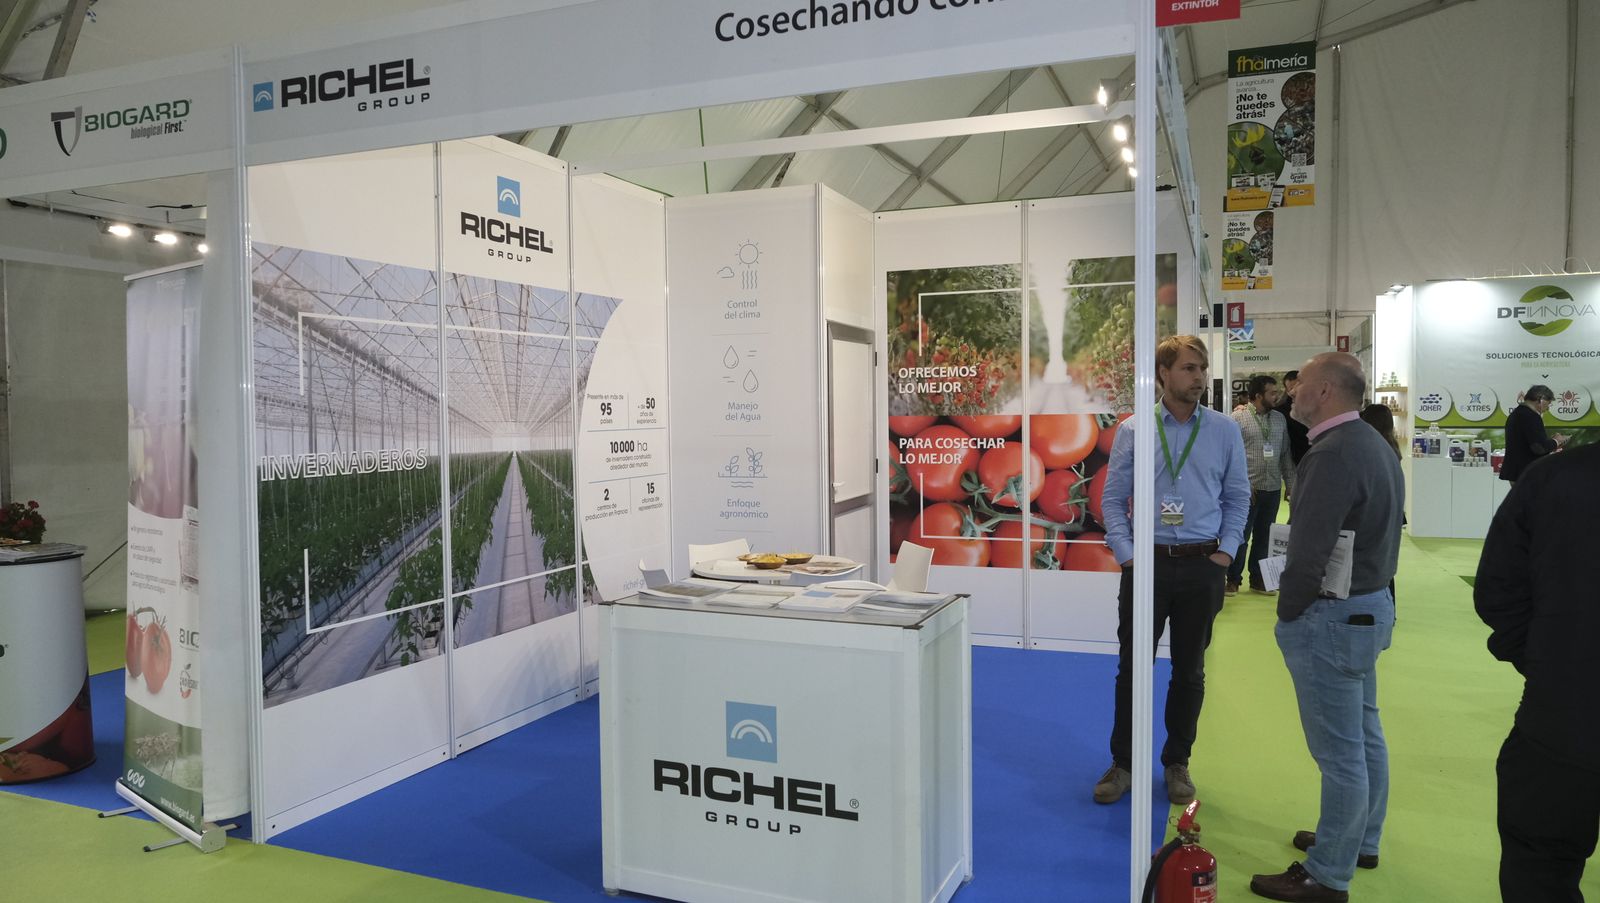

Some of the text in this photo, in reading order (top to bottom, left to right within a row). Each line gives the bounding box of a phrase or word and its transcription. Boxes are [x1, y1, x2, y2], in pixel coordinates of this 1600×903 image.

[1171, 0, 1220, 11] EXTINTOR
[714, 0, 919, 42] Cosechando
[357, 92, 431, 112] GROUP
[1236, 92, 1268, 104] ¡No te
[1236, 100, 1276, 113] quedes
[85, 99, 190, 133] BIOGARD
[1236, 109, 1266, 120] atrás!
[131, 123, 163, 139] biological
[487, 248, 532, 263] GROUP
[727, 299, 758, 309] Control
[724, 310, 761, 320] del clima
[1486, 352, 1539, 360] SOLUCIONES
[898, 366, 977, 378] OFRECEMOS
[898, 381, 961, 394] LO MEJOR
[600, 402, 612, 416] 95
[646, 397, 655, 409] 50
[727, 401, 759, 412] Manejo
[725, 412, 761, 423] del Agua
[637, 439, 648, 452] ha
[899, 437, 1005, 449] PARA COSECHAR
[260, 447, 428, 482] INVERNADEROS
[899, 453, 962, 465] LO MEJOR
[647, 482, 655, 494] 15
[603, 488, 610, 501] 2
[727, 499, 760, 510] Enfoque
[719, 509, 769, 520] agronómico
[705, 811, 801, 835] GROUP
